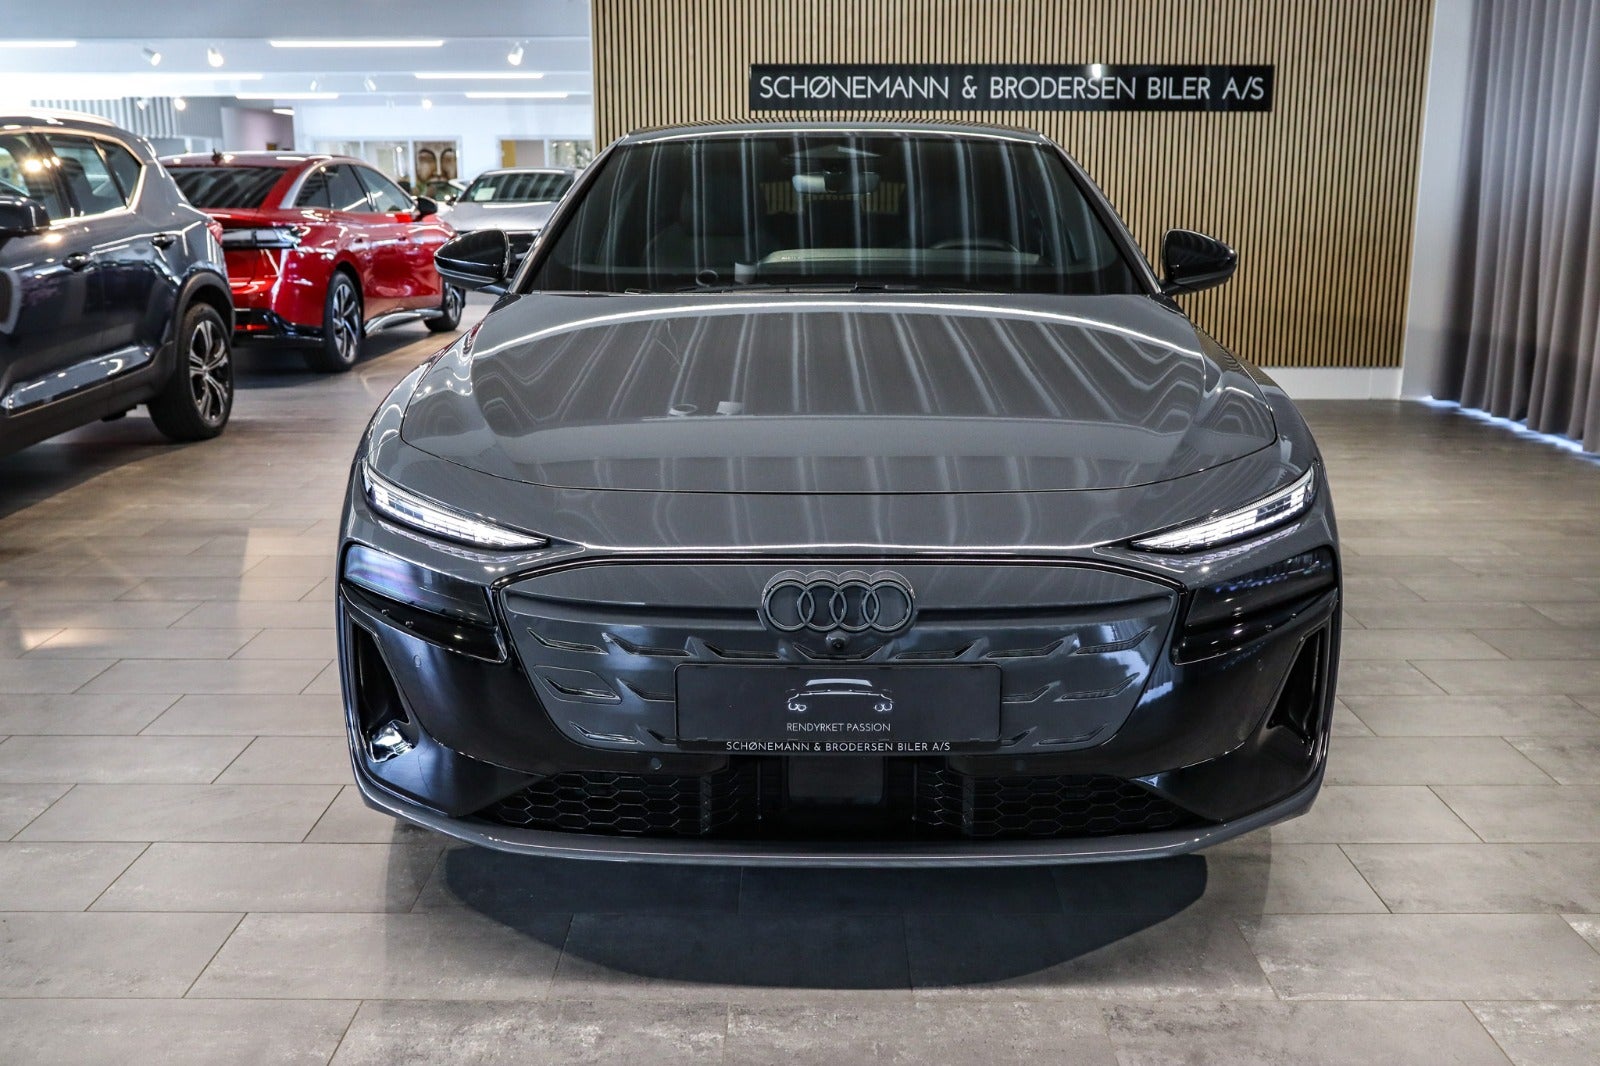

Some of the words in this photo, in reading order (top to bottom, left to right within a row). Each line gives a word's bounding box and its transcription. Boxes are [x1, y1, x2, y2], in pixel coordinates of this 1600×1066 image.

[759, 75, 949, 99] SCHØNEMANN
[961, 75, 978, 99] &
[990, 76, 1136, 100] BRODERSEN
[1147, 76, 1211, 100] BILER
[1222, 76, 1264, 100] A/S
[786, 722, 845, 732] RENDYRKET
[846, 722, 891, 732] PASSION
[726, 741, 810, 751] SCHØNEMANN
[813, 742, 821, 752] &
[825, 742, 893, 752] BRODERSEN
[897, 742, 928, 752] BILER
[932, 741, 951, 751] A/S
